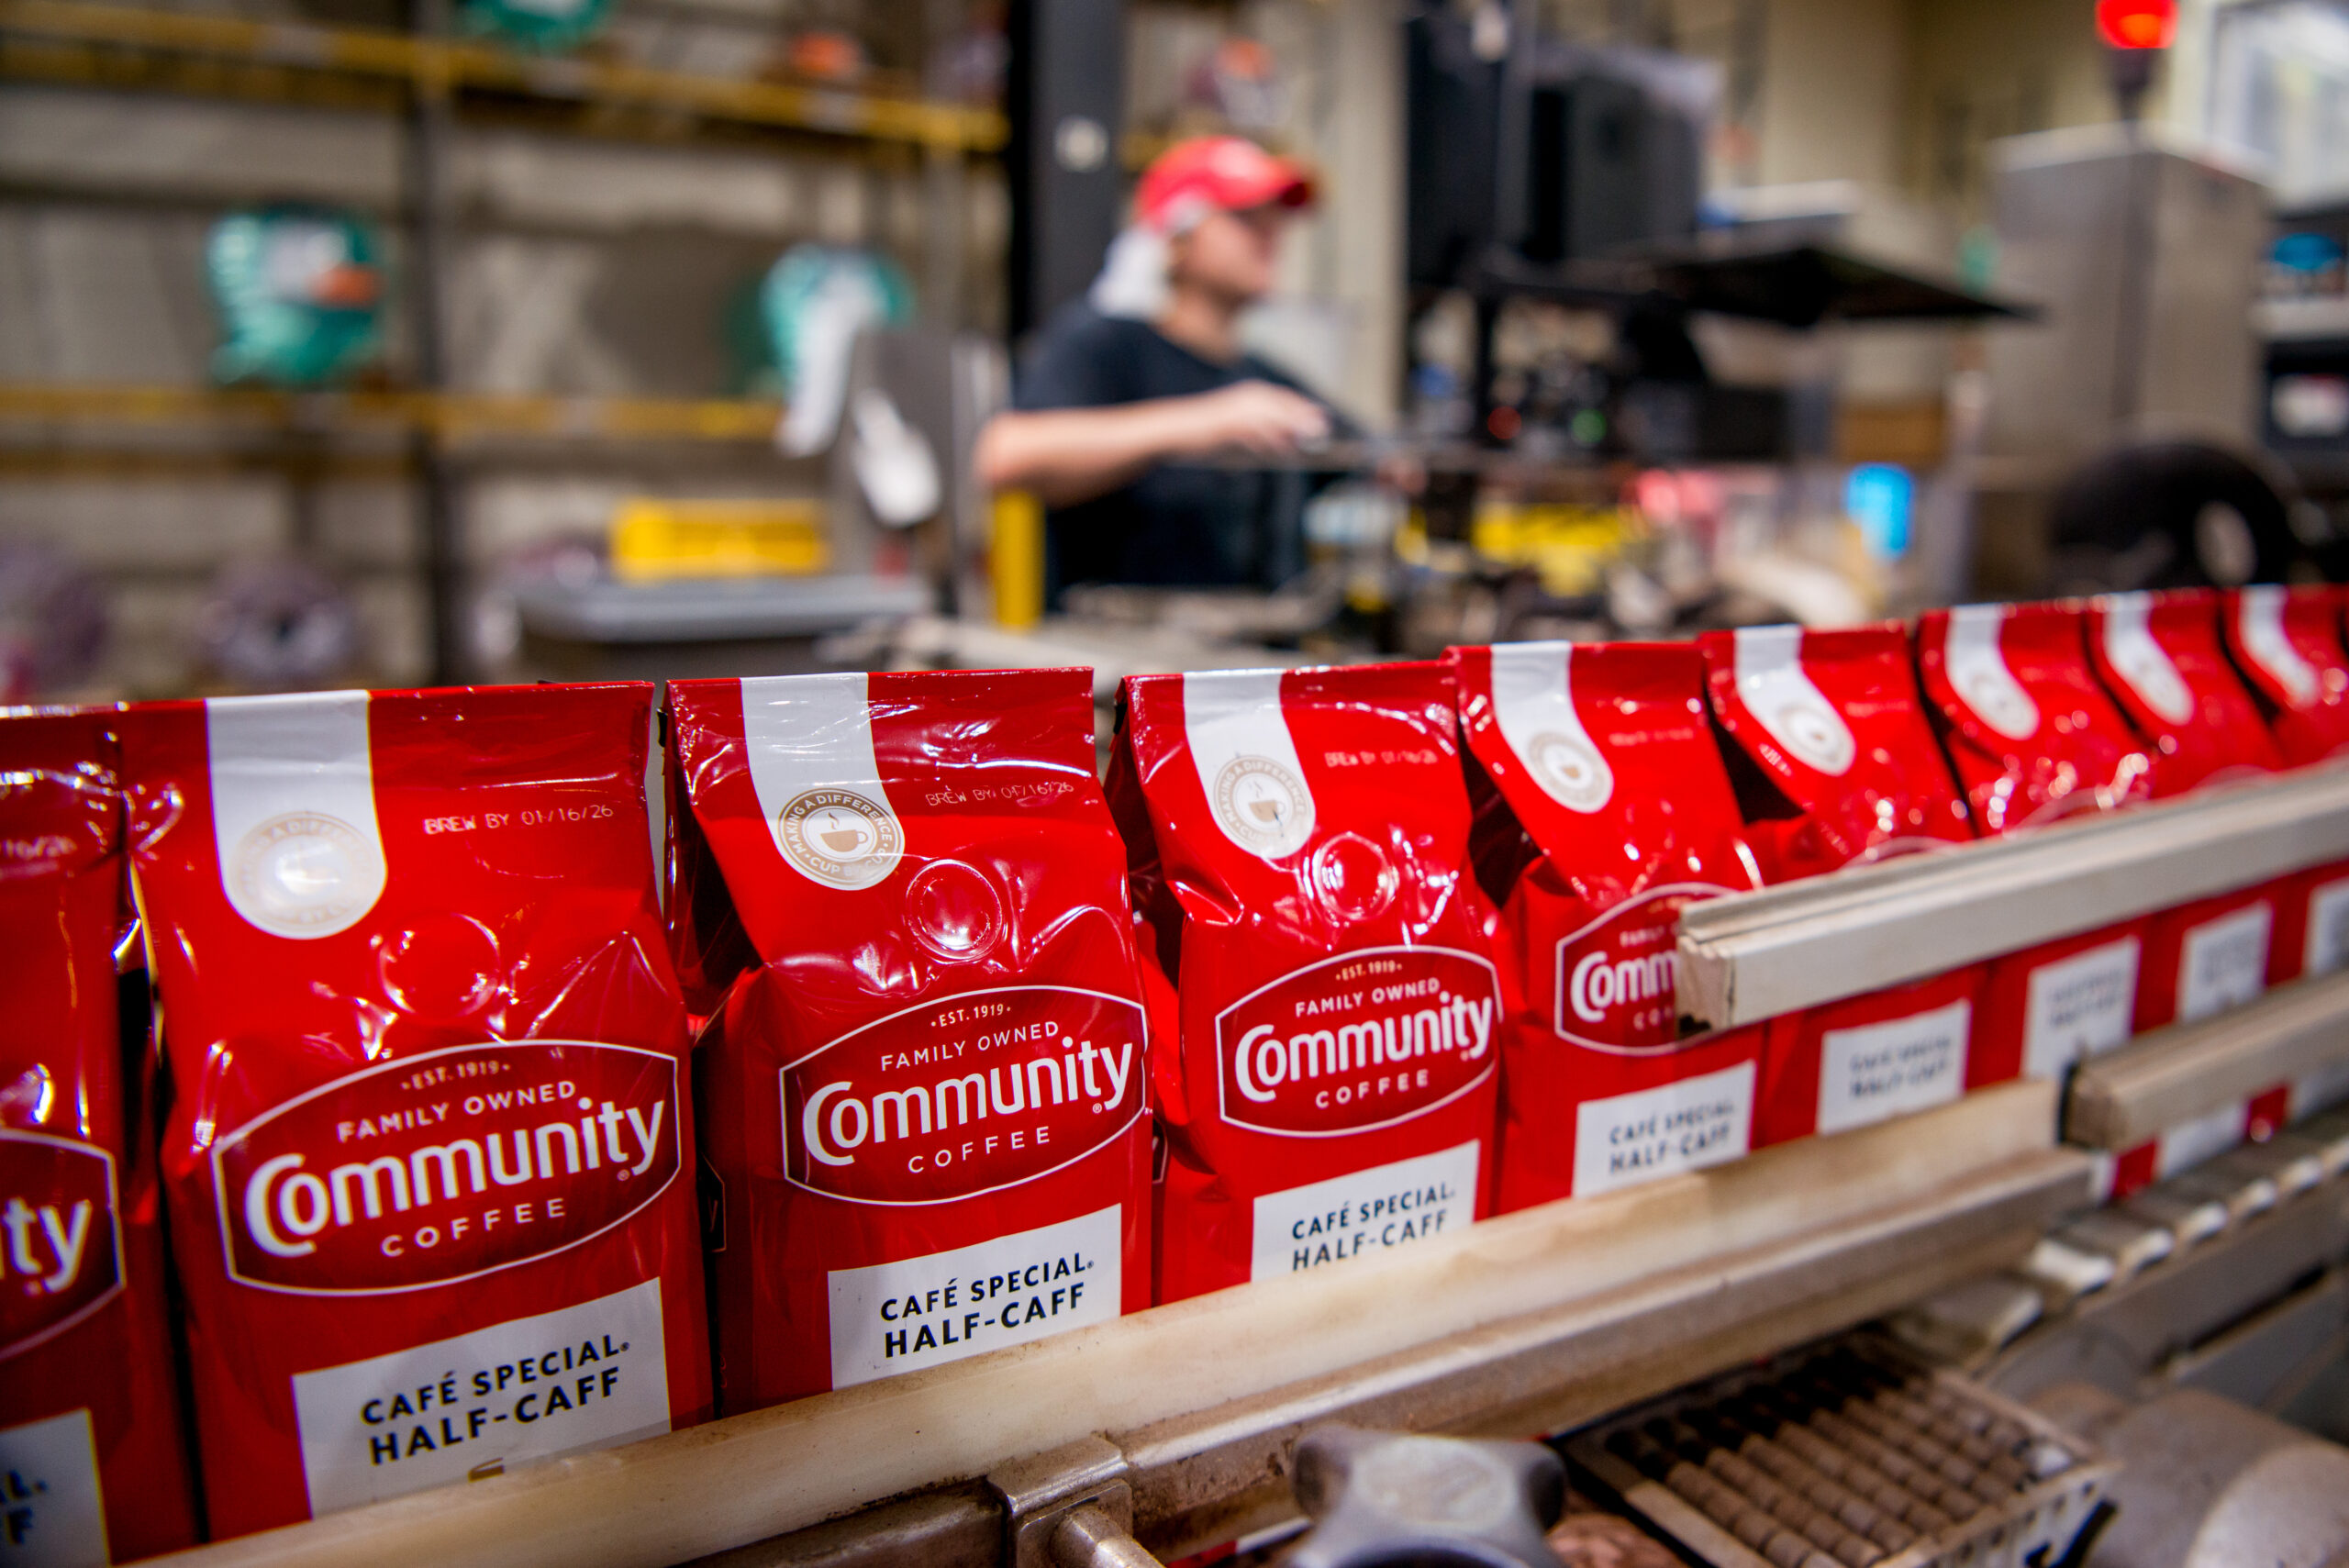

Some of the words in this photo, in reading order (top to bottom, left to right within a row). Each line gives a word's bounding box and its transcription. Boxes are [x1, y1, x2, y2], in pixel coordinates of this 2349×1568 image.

[925, 792, 967, 806] BREW
[973, 789, 992, 801] BY
[423, 816, 477, 835] BREW
[484, 813, 510, 828] BY
[785, 806, 807, 854] MAKING
[805, 798, 816, 809] A
[816, 794, 893, 841] DIFFERENCE
[810, 856, 841, 874] CUP
[938, 1009, 971, 1028] EST.
[973, 1003, 1005, 1019] 1919
[1295, 991, 1364, 1018] FAMILY
[1372, 977, 1440, 1004] OWNED
[880, 1041, 966, 1072] FAMILY
[976, 1020, 1059, 1051] OWNED
[457, 1060, 499, 1079] 1919
[1315, 1069, 1429, 1109] COFFEE
[338, 1101, 450, 1143] FAMILY
[462, 1080, 576, 1116] OWNED
[907, 1126, 1051, 1174] COFFEE
[381, 1197, 568, 1258] COFFEE
[1292, 1201, 1350, 1240] CAFÉ
[1292, 1209, 1448, 1272] HALF-CAFF
[880, 1278, 959, 1321] CAFÉ
[884, 1282, 1085, 1358] HALF-CAFF
[360, 1370, 460, 1426] CAFÉ
[369, 1366, 622, 1466] HALF-CAFF
